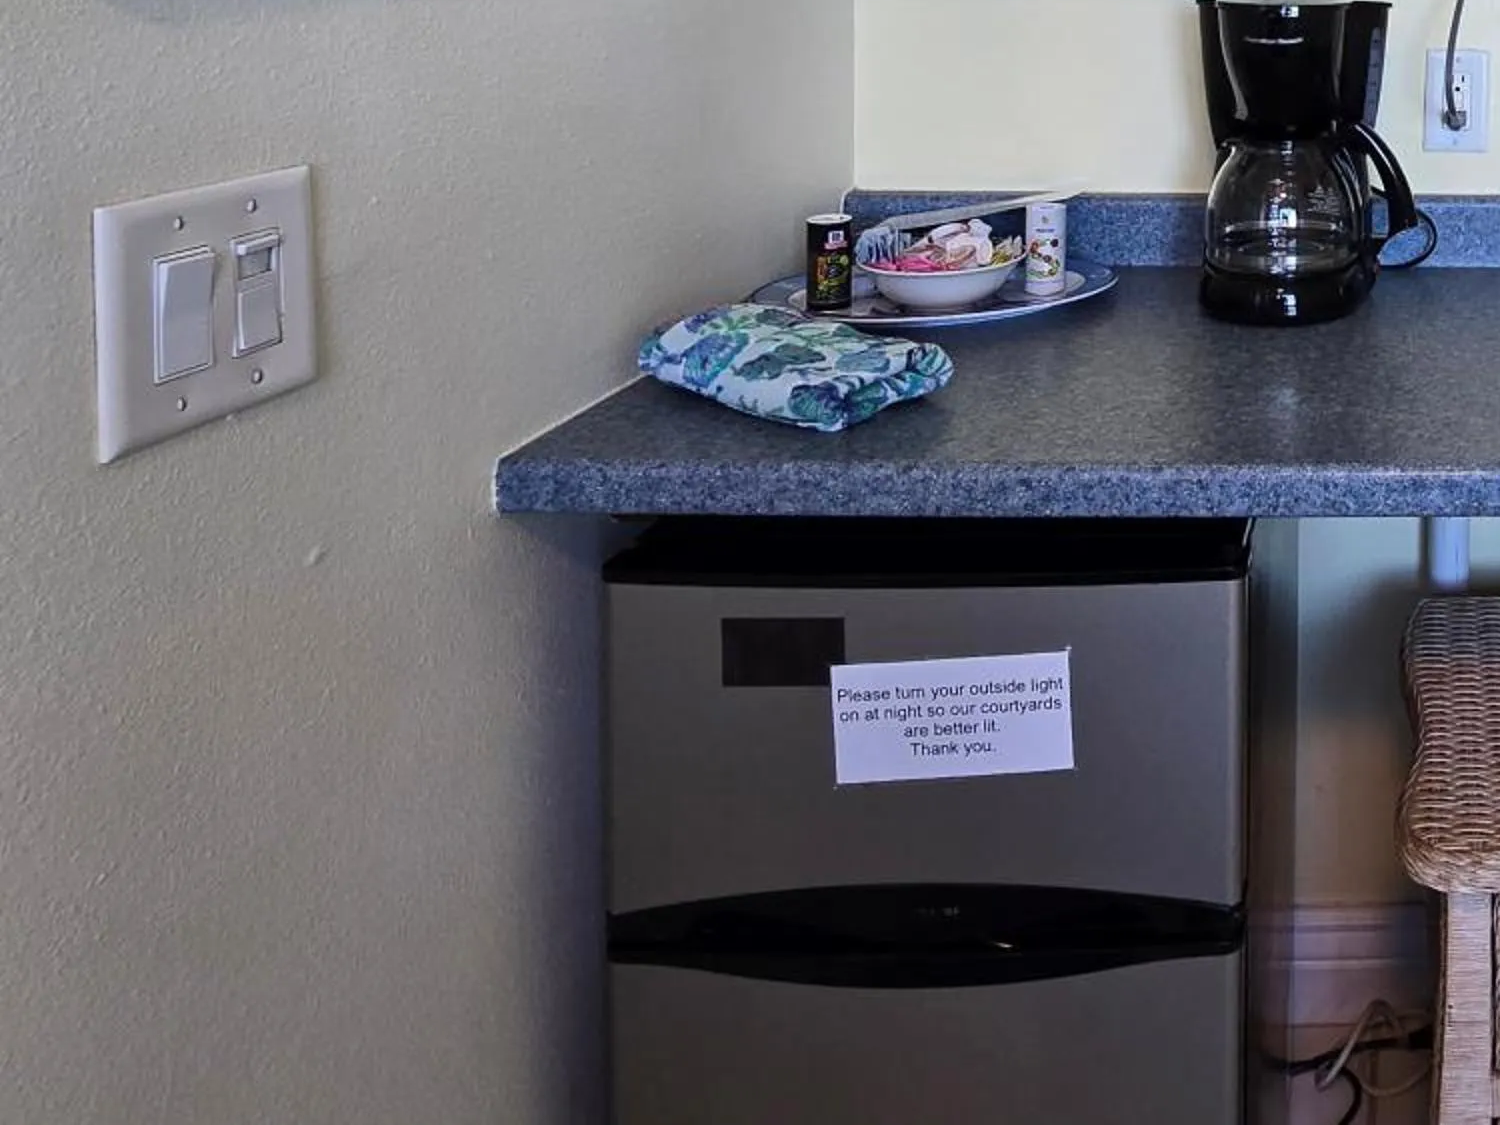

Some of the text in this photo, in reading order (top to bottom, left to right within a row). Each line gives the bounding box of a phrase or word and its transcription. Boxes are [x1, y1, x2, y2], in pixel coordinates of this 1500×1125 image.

[837, 677, 1063, 703] Please turn your outside light
[839, 696, 1062, 722] on at night so our courtyards
[903, 718, 1001, 738] are better lit.
[910, 741, 997, 757] Thank you.
